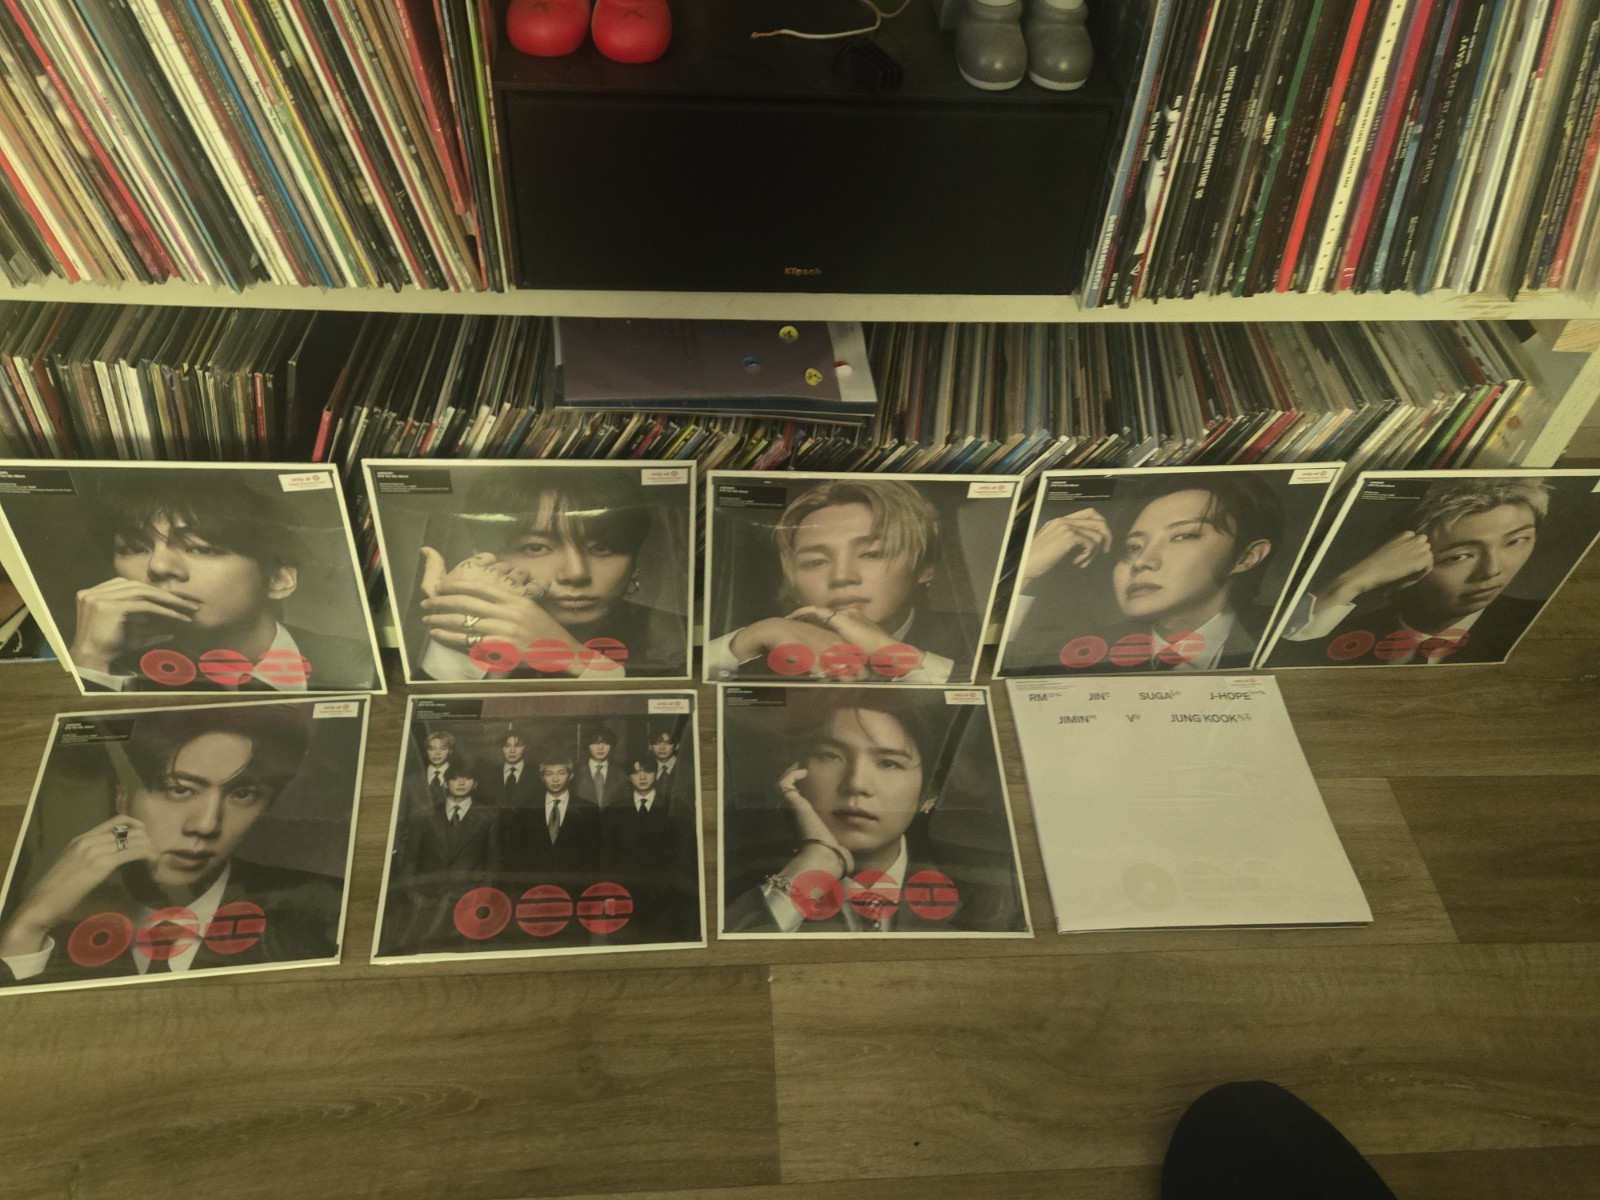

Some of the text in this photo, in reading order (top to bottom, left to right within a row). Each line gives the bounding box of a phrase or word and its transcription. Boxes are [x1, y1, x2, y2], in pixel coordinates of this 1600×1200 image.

[1224, 65, 1237, 91] VINCE
[1445, 70, 1459, 97] THE
[1213, 92, 1230, 129] STAPLES
[1433, 100, 1450, 139] BLACK
[1197, 136, 1219, 187] SUMMERTIME
[1421, 144, 1437, 184] ALBUM
[784, 266, 822, 276] Klipsch
[1028, 694, 1048, 702] RM
[1088, 692, 1105, 700] JIN
[1138, 692, 1173, 700] SUGA
[1209, 692, 1252, 700] J-HOPE
[1057, 715, 1090, 724] JIMIN
[1126, 714, 1136, 722] V
[1170, 714, 1238, 722] JUNG KOOK
